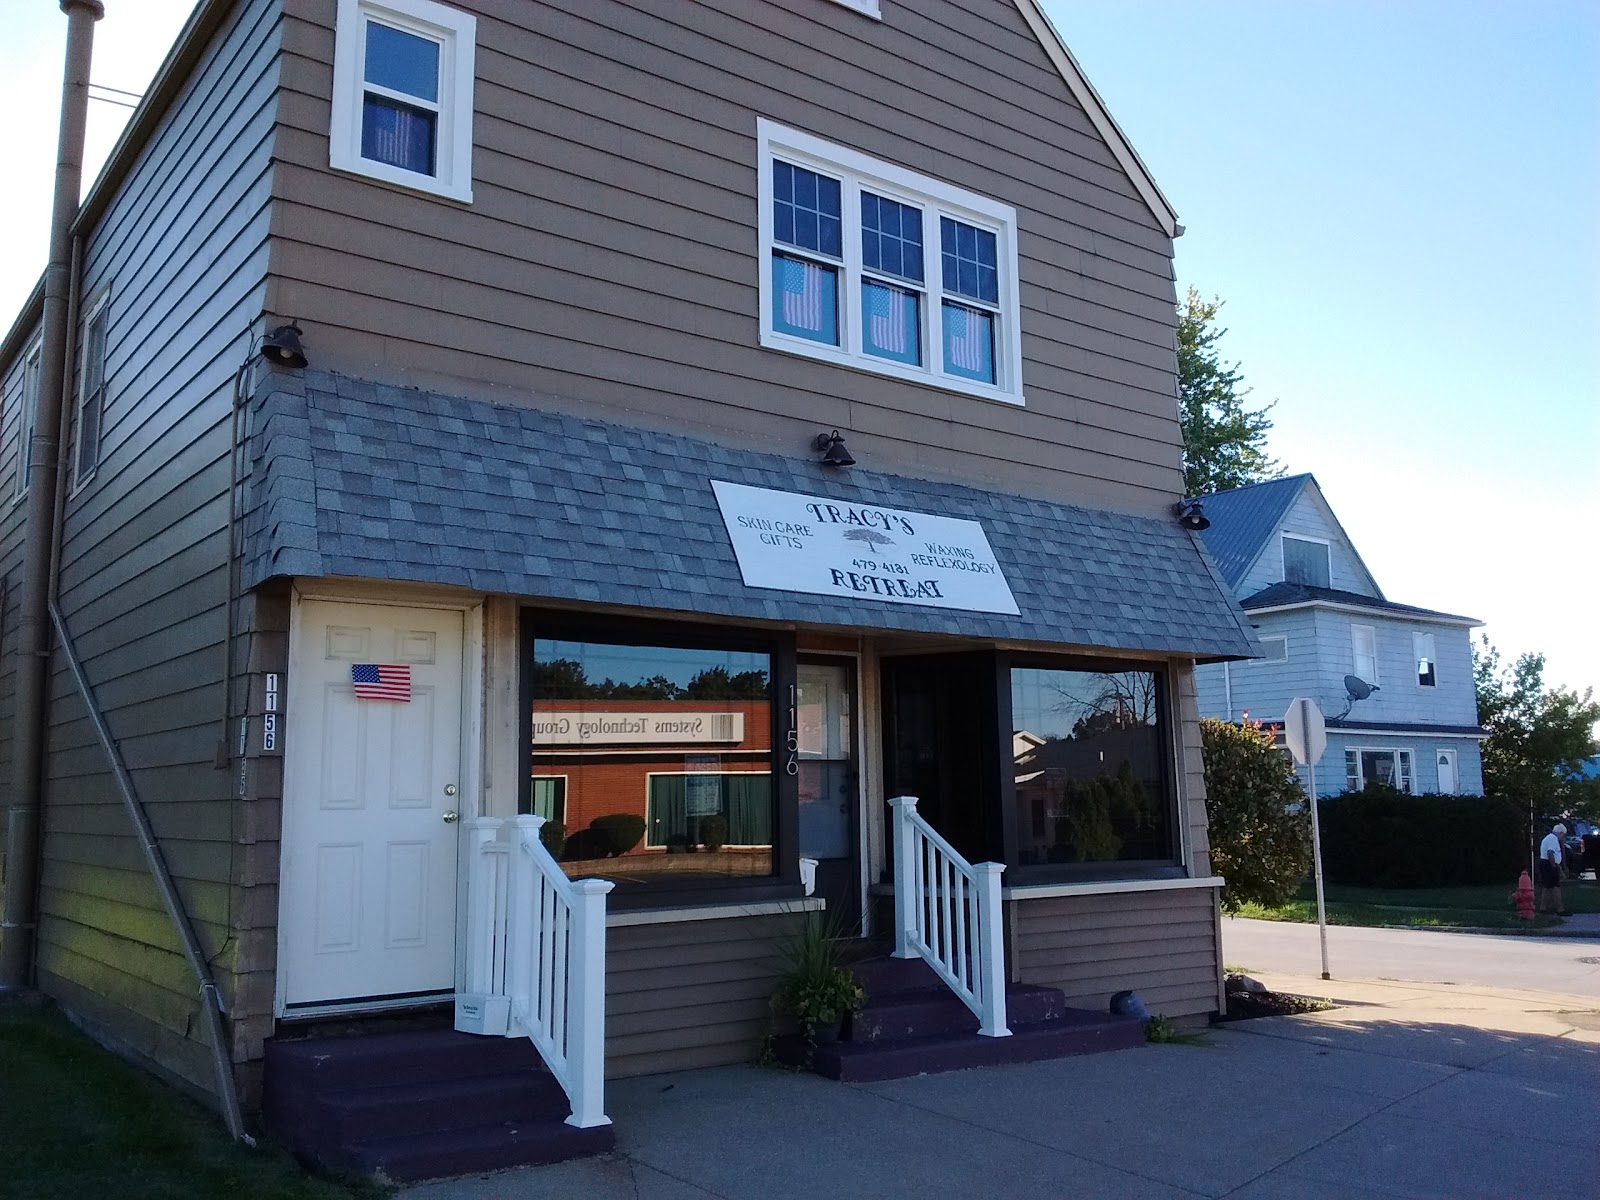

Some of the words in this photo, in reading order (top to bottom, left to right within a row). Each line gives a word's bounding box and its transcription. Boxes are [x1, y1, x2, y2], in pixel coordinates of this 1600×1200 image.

[737, 515, 773, 531] SKIN
[774, 521, 814, 537] CARE
[805, 503, 915, 536] TRACY'S
[759, 532, 803, 550] GIFTS
[924, 542, 975, 560] WAXING
[910, 553, 996, 575] REFLEXOLOGY
[828, 567, 945, 599] RETREAT
[265, 674, 276, 749] 1156
[786, 684, 798, 775] 1156
